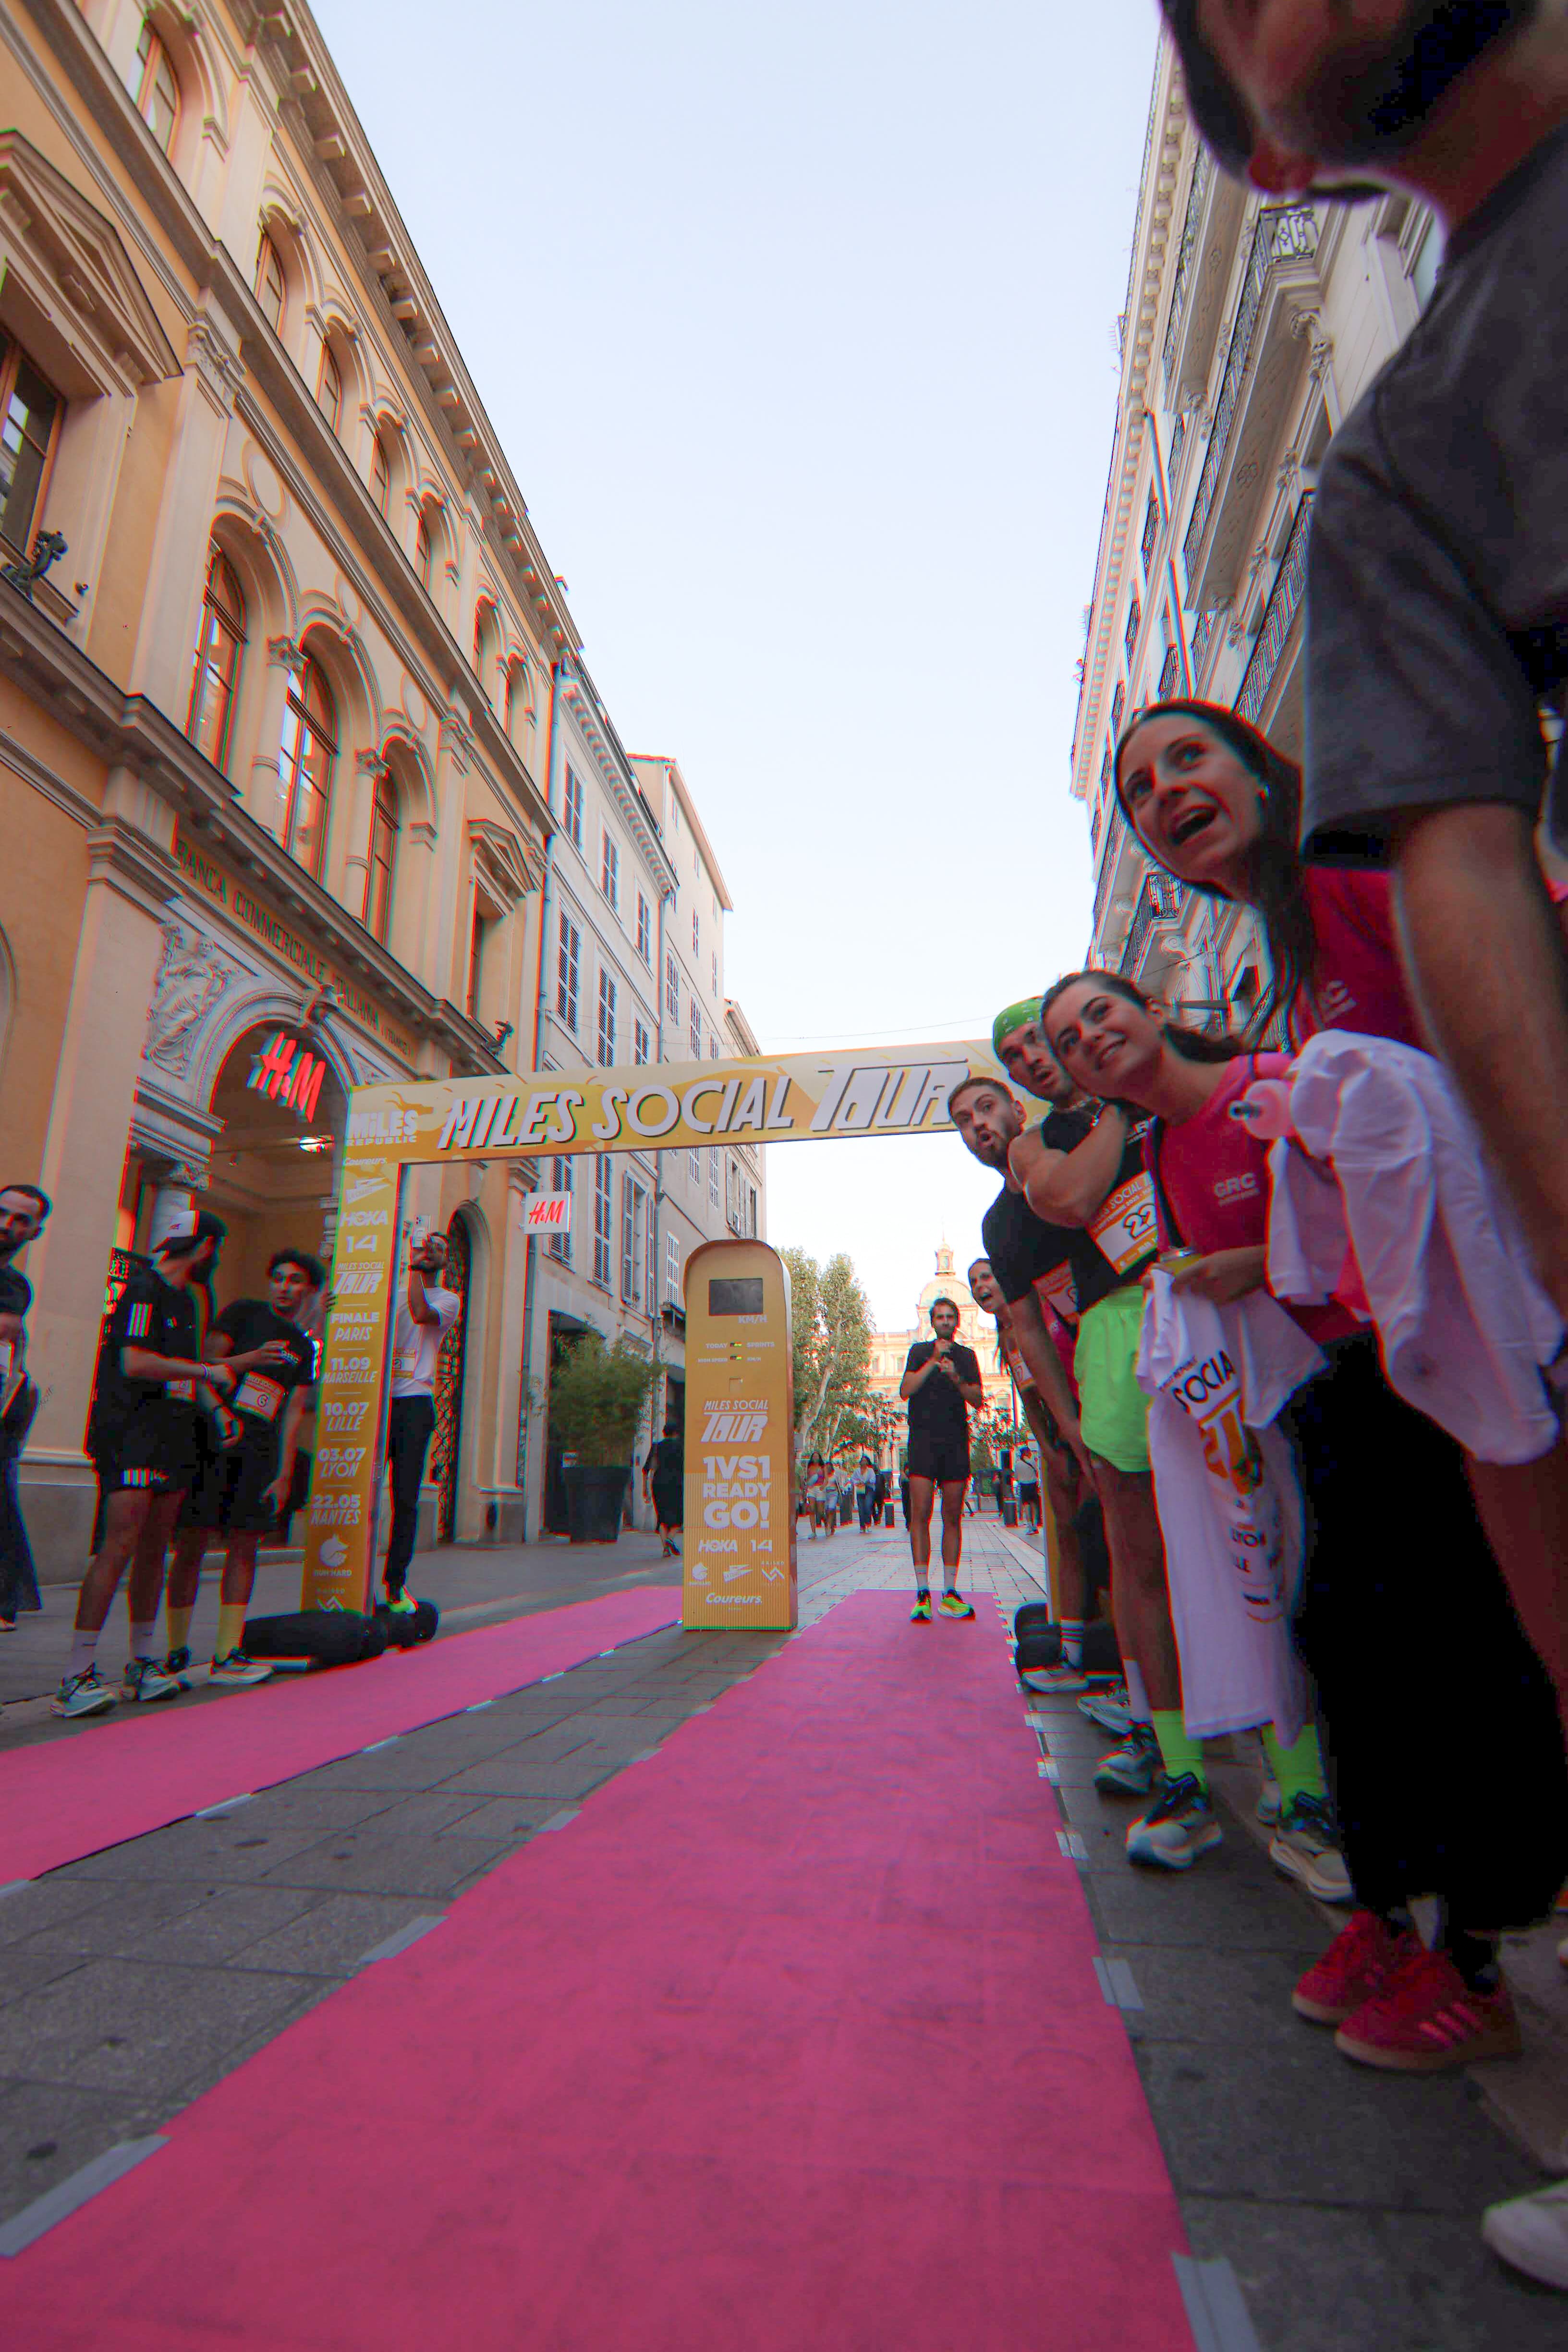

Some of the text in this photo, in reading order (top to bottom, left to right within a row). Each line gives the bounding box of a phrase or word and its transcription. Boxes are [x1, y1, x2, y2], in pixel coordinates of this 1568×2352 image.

[233, 890, 328, 985] COMMERCIALE
[253, 1031, 327, 1123] H&M
[438, 1089, 584, 1150] MILES
[592, 1075, 795, 1140] SOCIAL
[809, 1058, 971, 1132] TOUR
[346, 1135, 417, 1147] REPUBLIC
[1213, 1173, 1257, 1199] GRC
[340, 1210, 388, 1227] HOKA
[529, 1200, 566, 1224] H&M
[346, 1235, 377, 1253] 14
[338, 1261, 385, 1271] MILES SOCIAL
[333, 1271, 383, 1295] TOUR
[330, 1312, 380, 1324] FINALE
[738, 1314, 768, 1324] KM/H
[334, 1326, 372, 1341] PARIS
[330, 1357, 371, 1371] 11.09
[322, 1370, 377, 1384] MARSEILLE
[1173, 1350, 1237, 1415] SOCIA
[324, 1402, 369, 1417] 10.07
[704, 1400, 768, 1411] MILES SOCIAL
[326, 1416, 364, 1431] LILLE
[701, 1412, 768, 1443] TOUR
[318, 1447, 367, 1462] 03.07
[320, 1461, 360, 1478] LYON
[703, 1455, 771, 1480] 1VS1
[703, 1483, 772, 1498] READY
[313, 1493, 361, 1509] 22.05
[311, 1508, 362, 1526] NANTES
[704, 1501, 770, 1529] GO!
[698, 1540, 738, 1553] HOKA
[750, 1540, 773, 1553] 14
